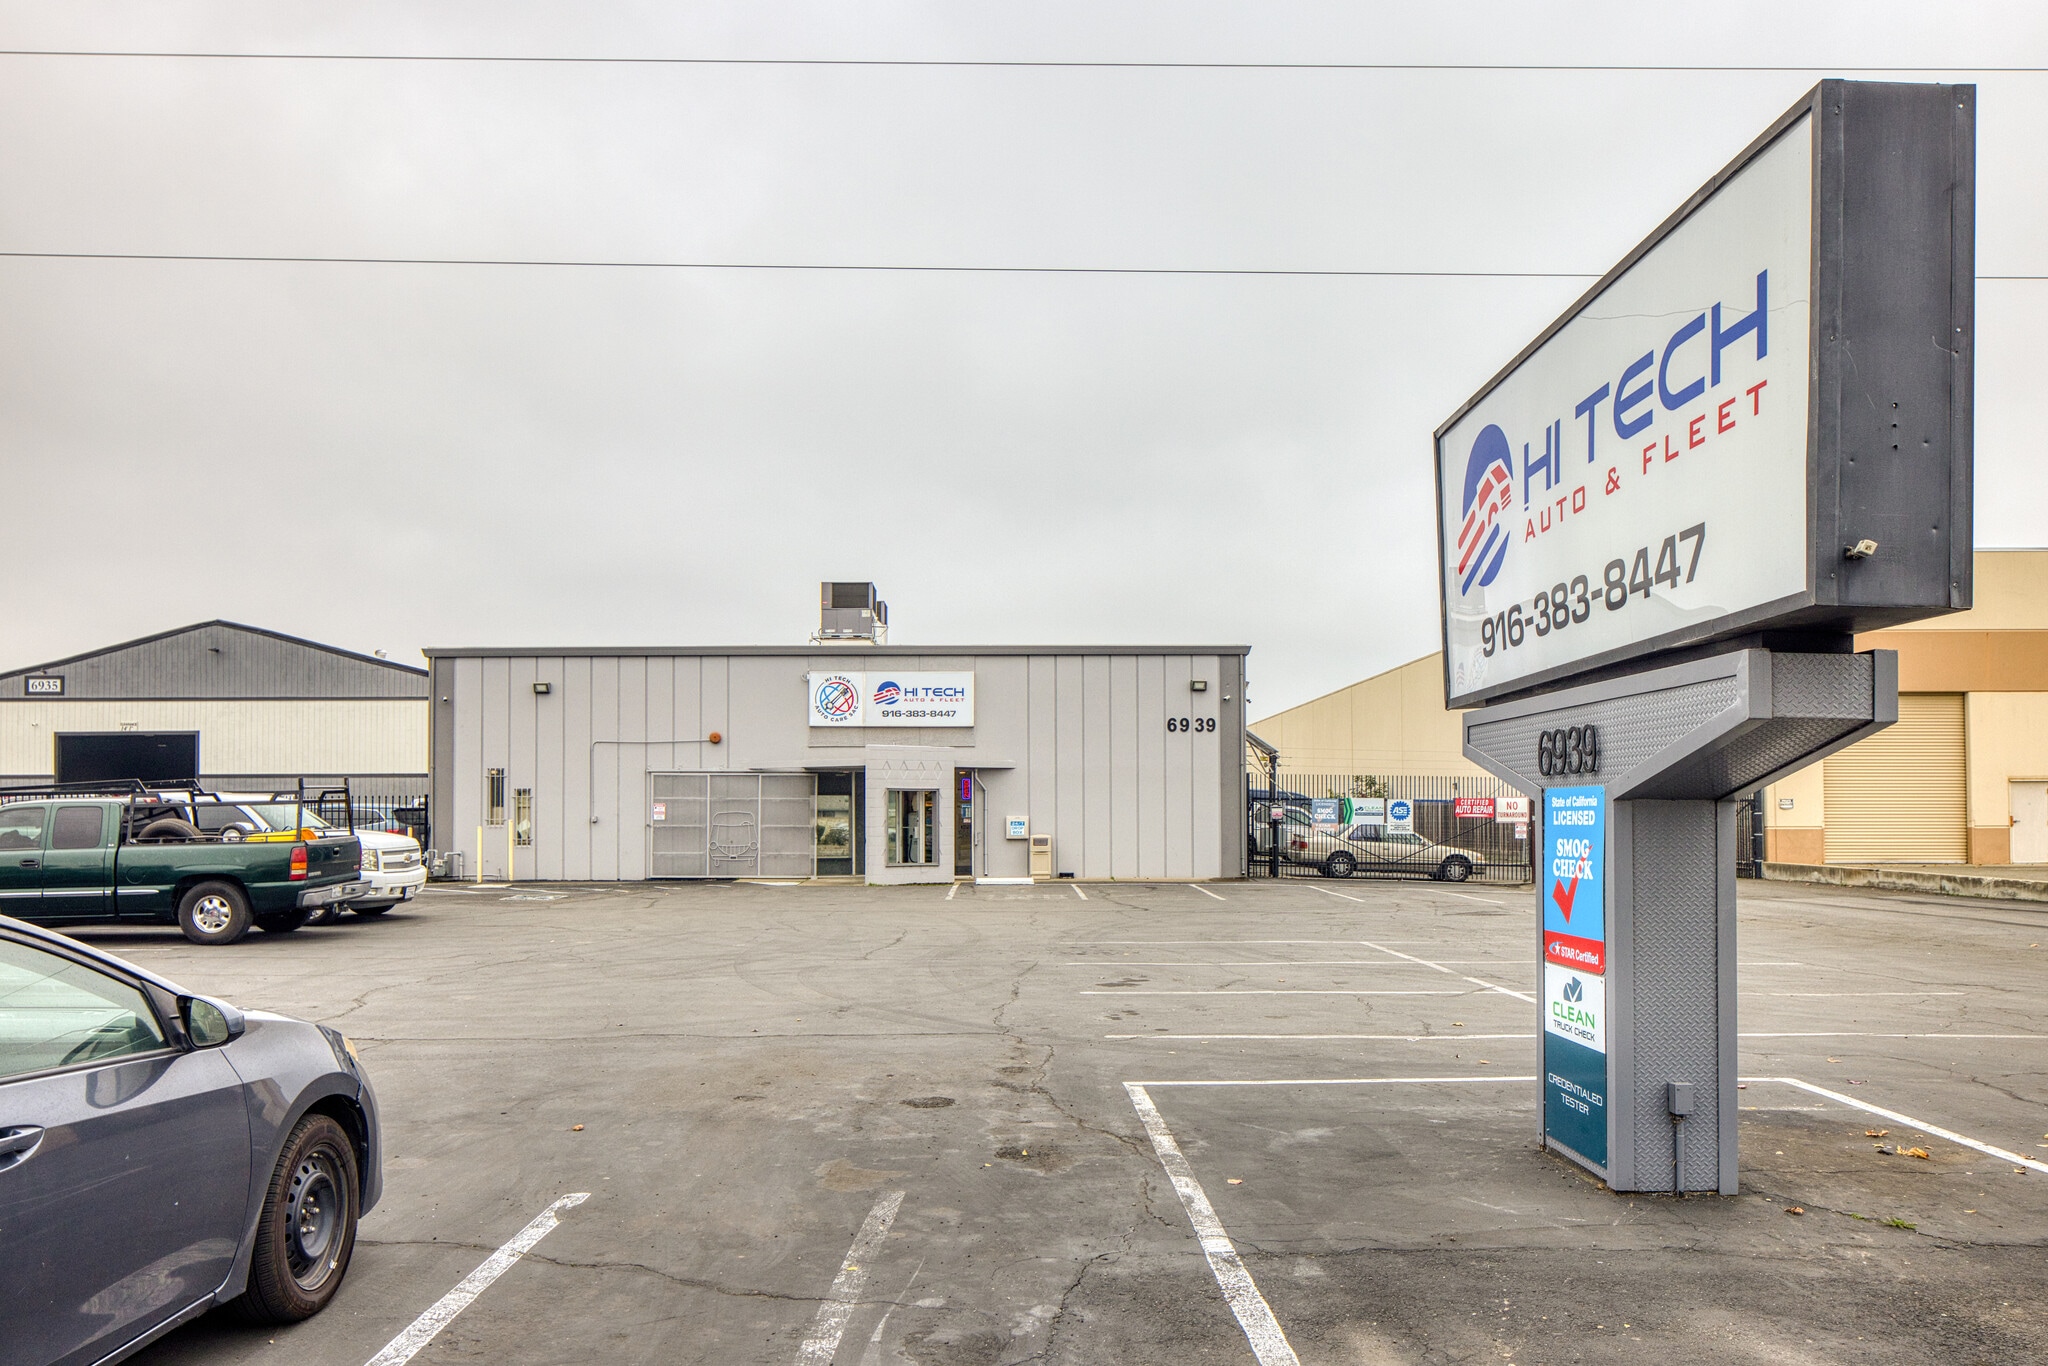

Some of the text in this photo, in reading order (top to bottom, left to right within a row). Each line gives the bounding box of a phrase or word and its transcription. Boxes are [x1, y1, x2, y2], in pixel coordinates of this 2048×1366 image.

[1524, 269, 1767, 512] HI TECH
[1525, 379, 1767, 543] AUTO & FLEET
[1481, 521, 1706, 658] 916-383-8447
[31, 680, 58, 691] 6935
[834, 675, 851, 684] TECH
[904, 687, 965, 697] HI TECH
[815, 705, 829, 720] AUTO
[848, 704, 859, 717] SAC
[882, 709, 957, 718] 916-383-8447
[1538, 723, 1598, 776] 6939
[1392, 806, 1408, 814] ASE
[1455, 805, 1493, 814] AUTO REPAIR
[1506, 801, 1519, 811] NO
[1552, 794, 1598, 808] State of California
[1553, 810, 1596, 826] LICENSED
[1556, 838, 1590, 858] SMOG
[1552, 858, 1594, 880] CHECK
[1560, 945, 1599, 966] STAR Certified
[1553, 1001, 1595, 1029] CLEAN
[1553, 1019, 1596, 1042] TRUCK CHECK
[1548, 1072, 1603, 1107] CREDENTIALED
[1560, 1092, 1590, 1116] TESTER
